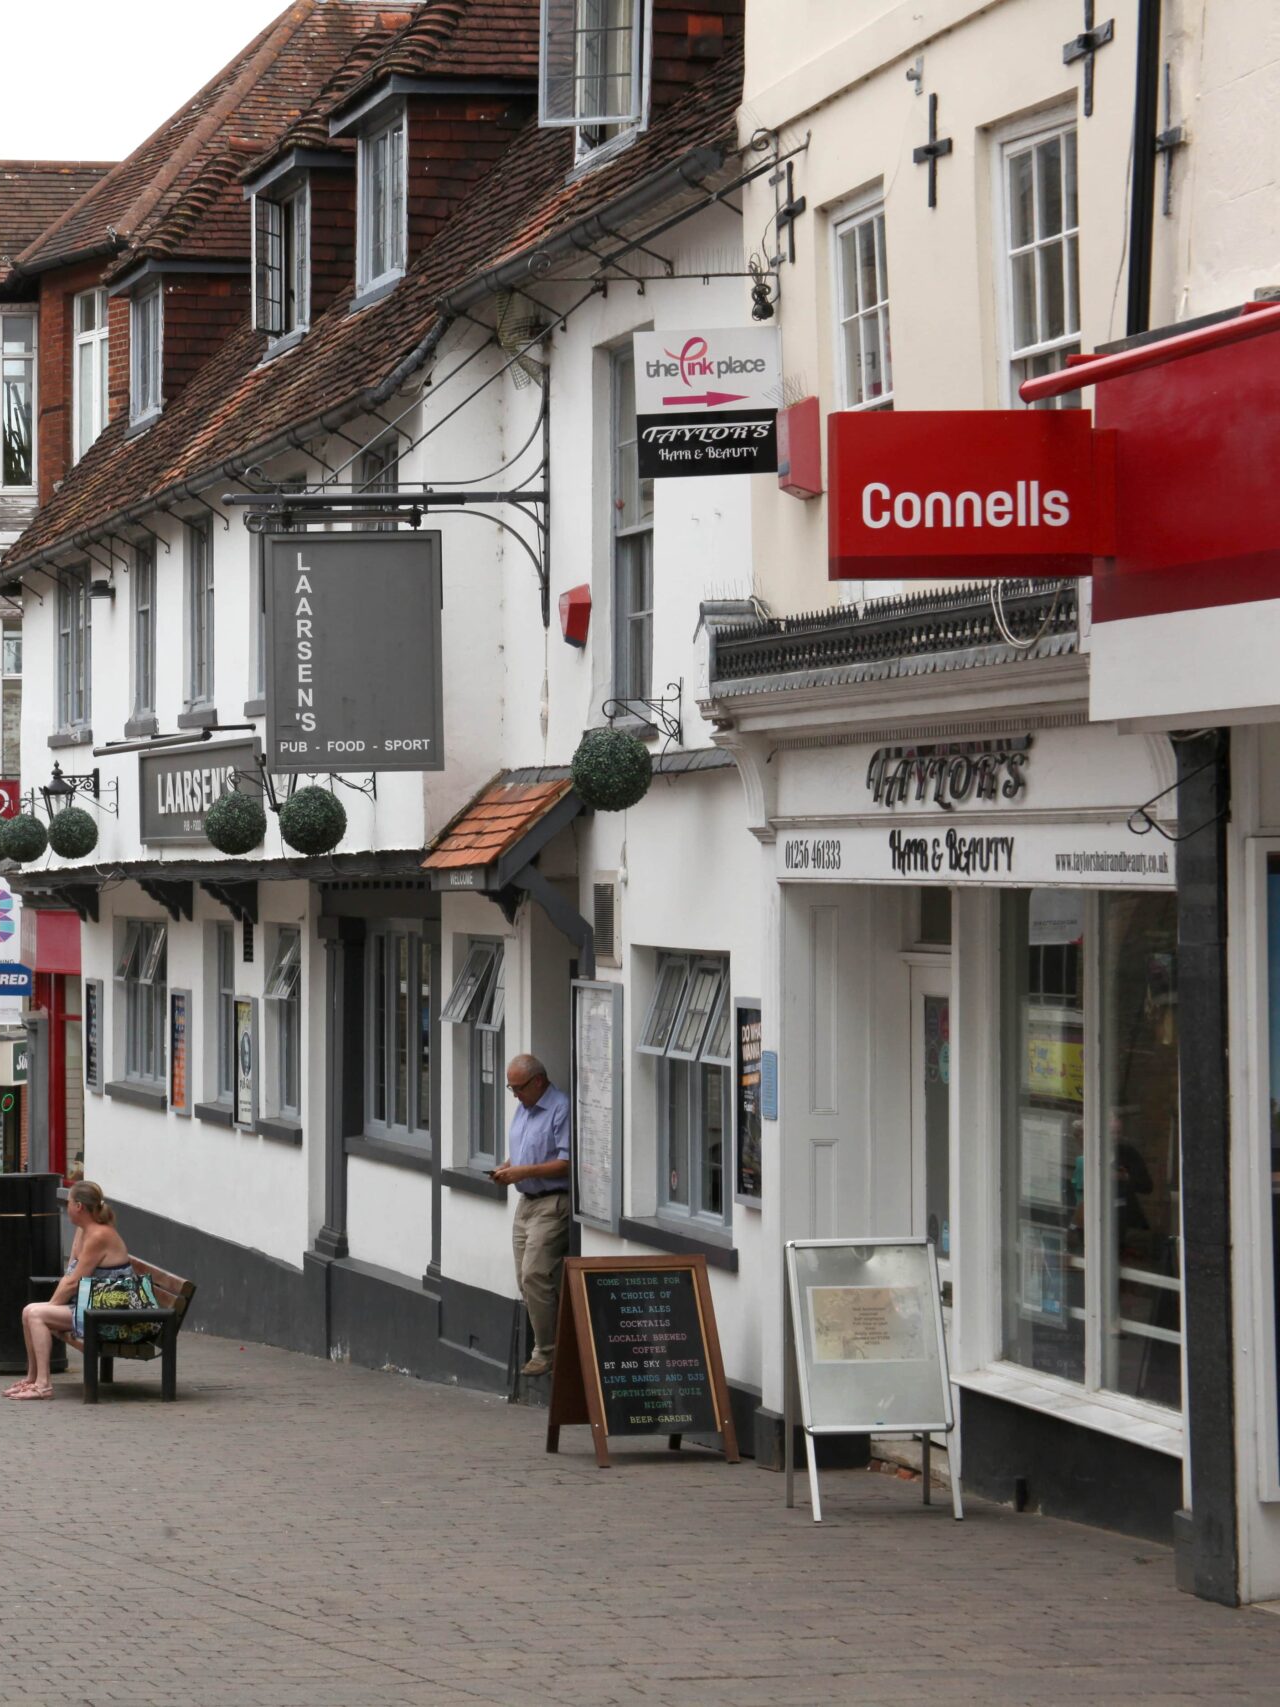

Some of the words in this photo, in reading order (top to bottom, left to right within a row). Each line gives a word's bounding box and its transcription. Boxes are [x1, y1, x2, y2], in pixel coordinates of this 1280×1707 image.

[645, 359, 679, 378] the
[717, 355, 766, 379] place
[641, 420, 774, 444] TAYLOR'S
[658, 448, 692, 462] HAIR
[694, 449, 703, 460] &
[705, 446, 759, 459] BEAUTY
[861, 480, 1070, 529] Connells
[294, 552, 317, 732] LAARSEN'S
[280, 741, 308, 753] PUB
[327, 740, 366, 752] FOOD
[384, 739, 430, 751] SPORT
[865, 734, 1032, 811] TAYLOR'S
[157, 765, 236, 814] LAARSEN'S
[785, 839, 809, 869] 01256
[811, 839, 841, 870] 461333
[889, 829, 929, 876] HAIR
[931, 838, 944, 872] &
[945, 828, 1015, 876] BEAUTY
[449, 871, 473, 885] WELCOME
[596, 1277, 620, 1286] COME
[625, 1277, 658, 1286] INSIDE
[663, 1276, 680, 1285] FOR
[610, 1292, 617, 1300] A
[620, 1291, 655, 1300] CHOICE
[660, 1290, 672, 1299] OF
[620, 1306, 644, 1314] REAL
[648, 1305, 671, 1313] ALES
[620, 1319, 671, 1328] COCKTAILS
[608, 1334, 648, 1343] LOCALLY
[653, 1333, 688, 1341] BREWED
[632, 1346, 667, 1354] COFFEE
[604, 1362, 615, 1370] BT
[621, 1361, 638, 1369] AND
[643, 1360, 660, 1368] SKY
[665, 1359, 700, 1367] SPORTS
[604, 1376, 627, 1384] LIVE
[631, 1375, 660, 1383] BANDS
[665, 1374, 683, 1382] AND
[611, 1388, 673, 1398] FORTNIGHTLY
[678, 1388, 702, 1397] QUIZ
[644, 1400, 673, 1409] NIGHT
[629, 1416, 654, 1424] BEER
[657, 1414, 692, 1423] GARDEN
